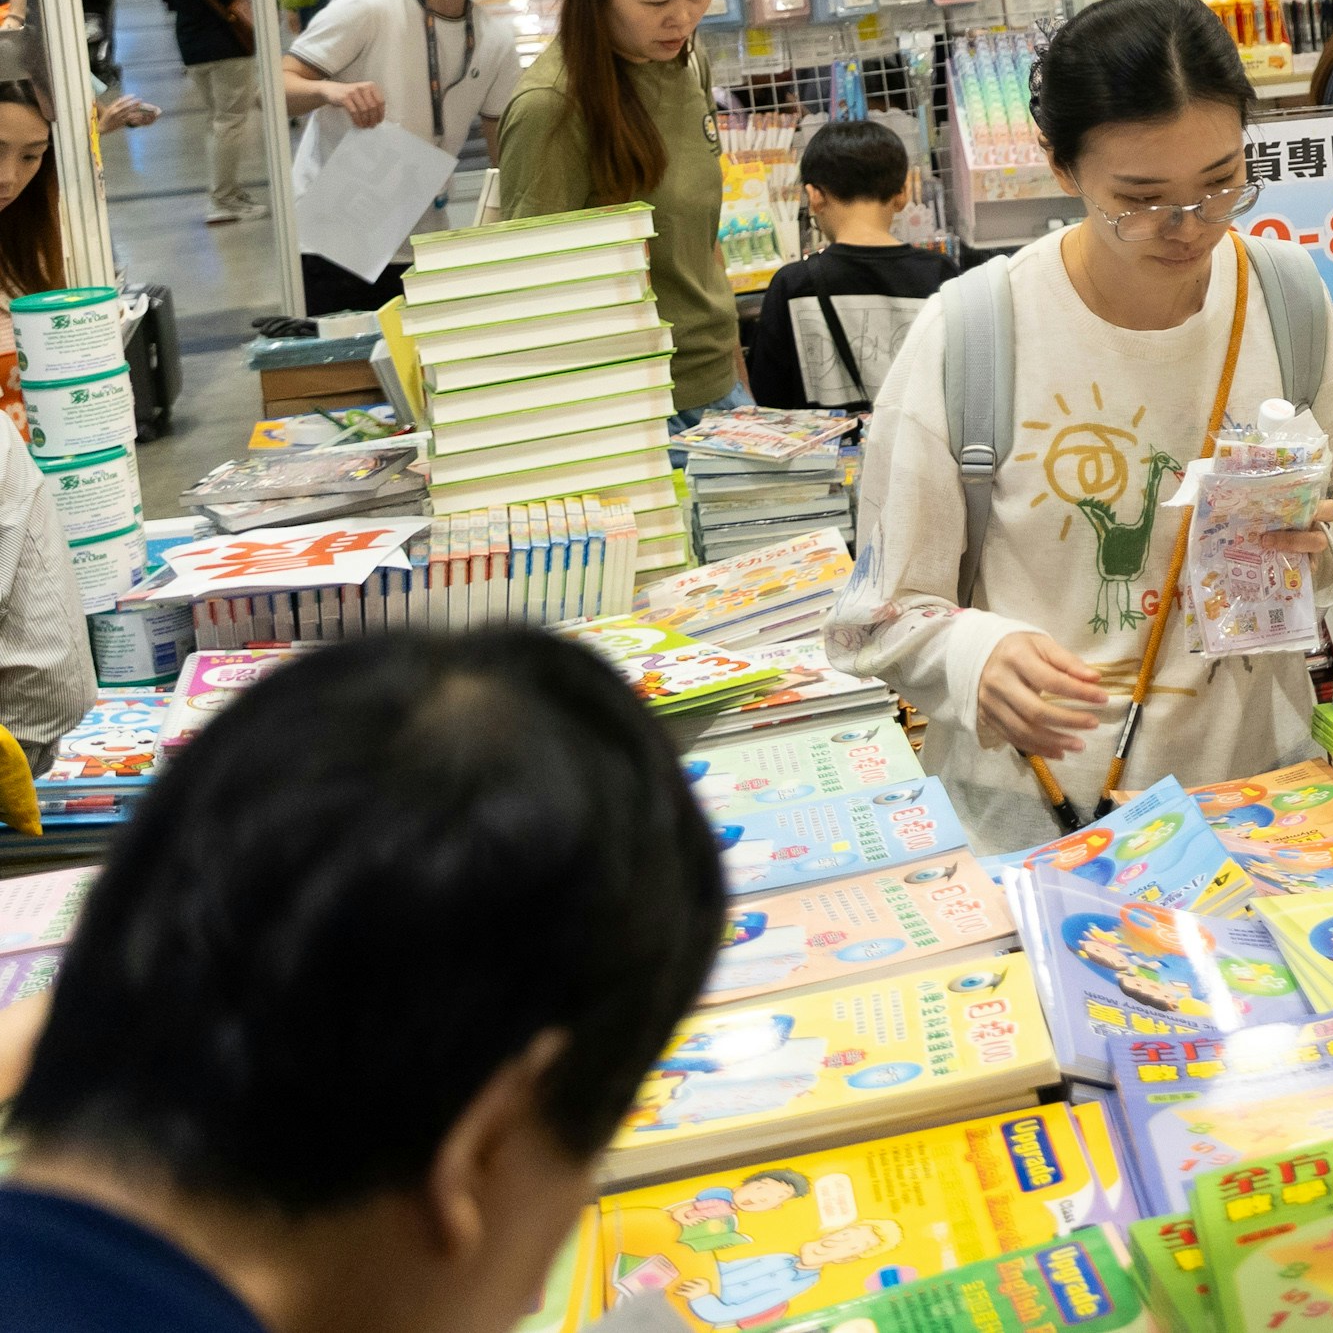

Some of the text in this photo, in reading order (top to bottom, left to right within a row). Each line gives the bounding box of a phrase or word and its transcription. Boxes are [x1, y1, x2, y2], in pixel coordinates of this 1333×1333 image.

[164, 529, 395, 581] 最
[1011, 1118, 1053, 1188] Upgrade
[1050, 1246, 1099, 1319] Upgrade
